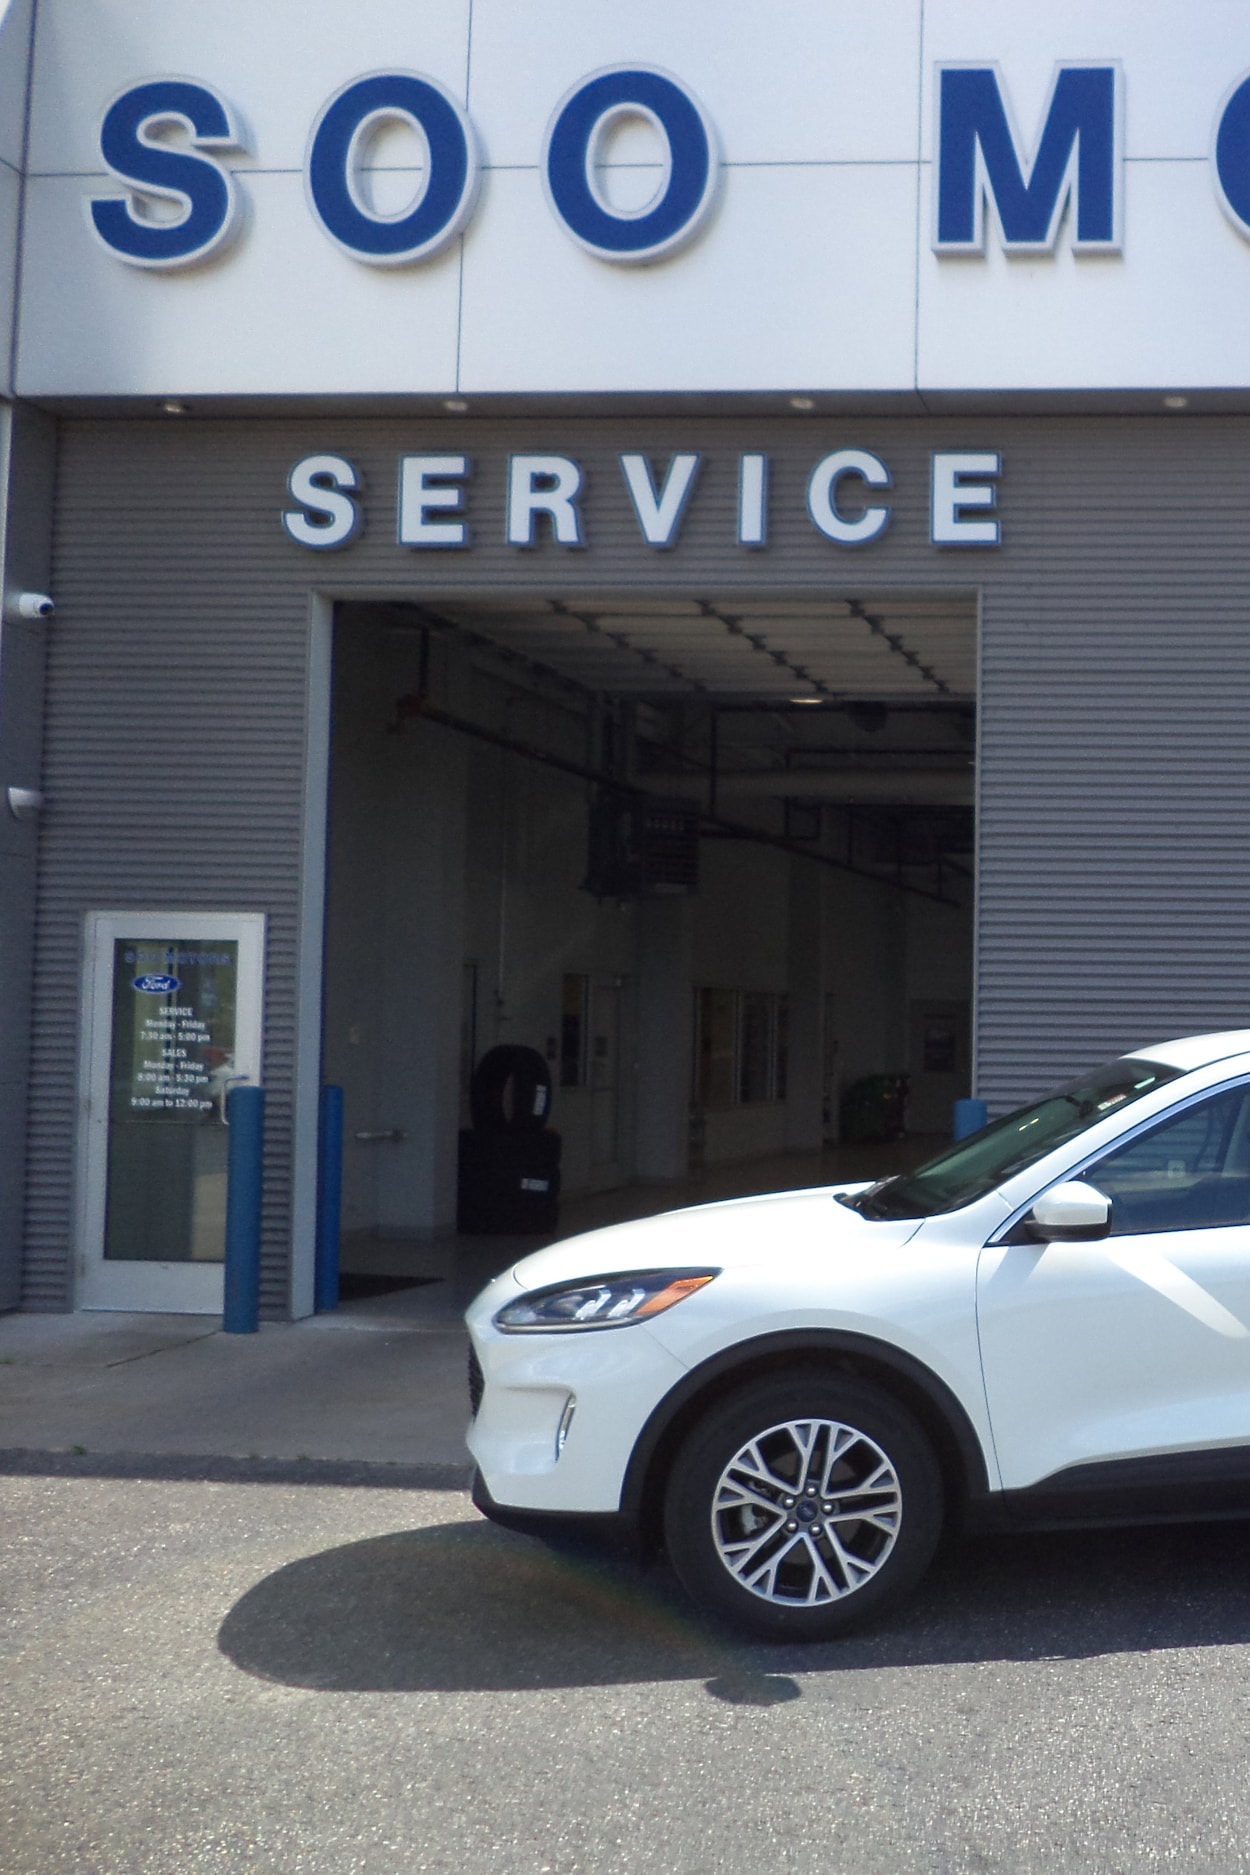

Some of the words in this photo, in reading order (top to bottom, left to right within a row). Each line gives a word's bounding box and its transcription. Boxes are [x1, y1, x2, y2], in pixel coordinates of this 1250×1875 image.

[86, 64, 715, 267] SOO
[282, 449, 1000, 548] SERVICE
[159, 1007, 193, 1016] SERVICE
[145, 1019, 176, 1029] Monday
[182, 1020, 205, 1030] Friday
[197, 1035, 210, 1043] pm
[162, 1048, 187, 1057] SALES
[180, 1061, 204, 1072] Friday
[155, 1086, 190, 1096] Saturday
[175, 1098, 199, 1108] 12:00
